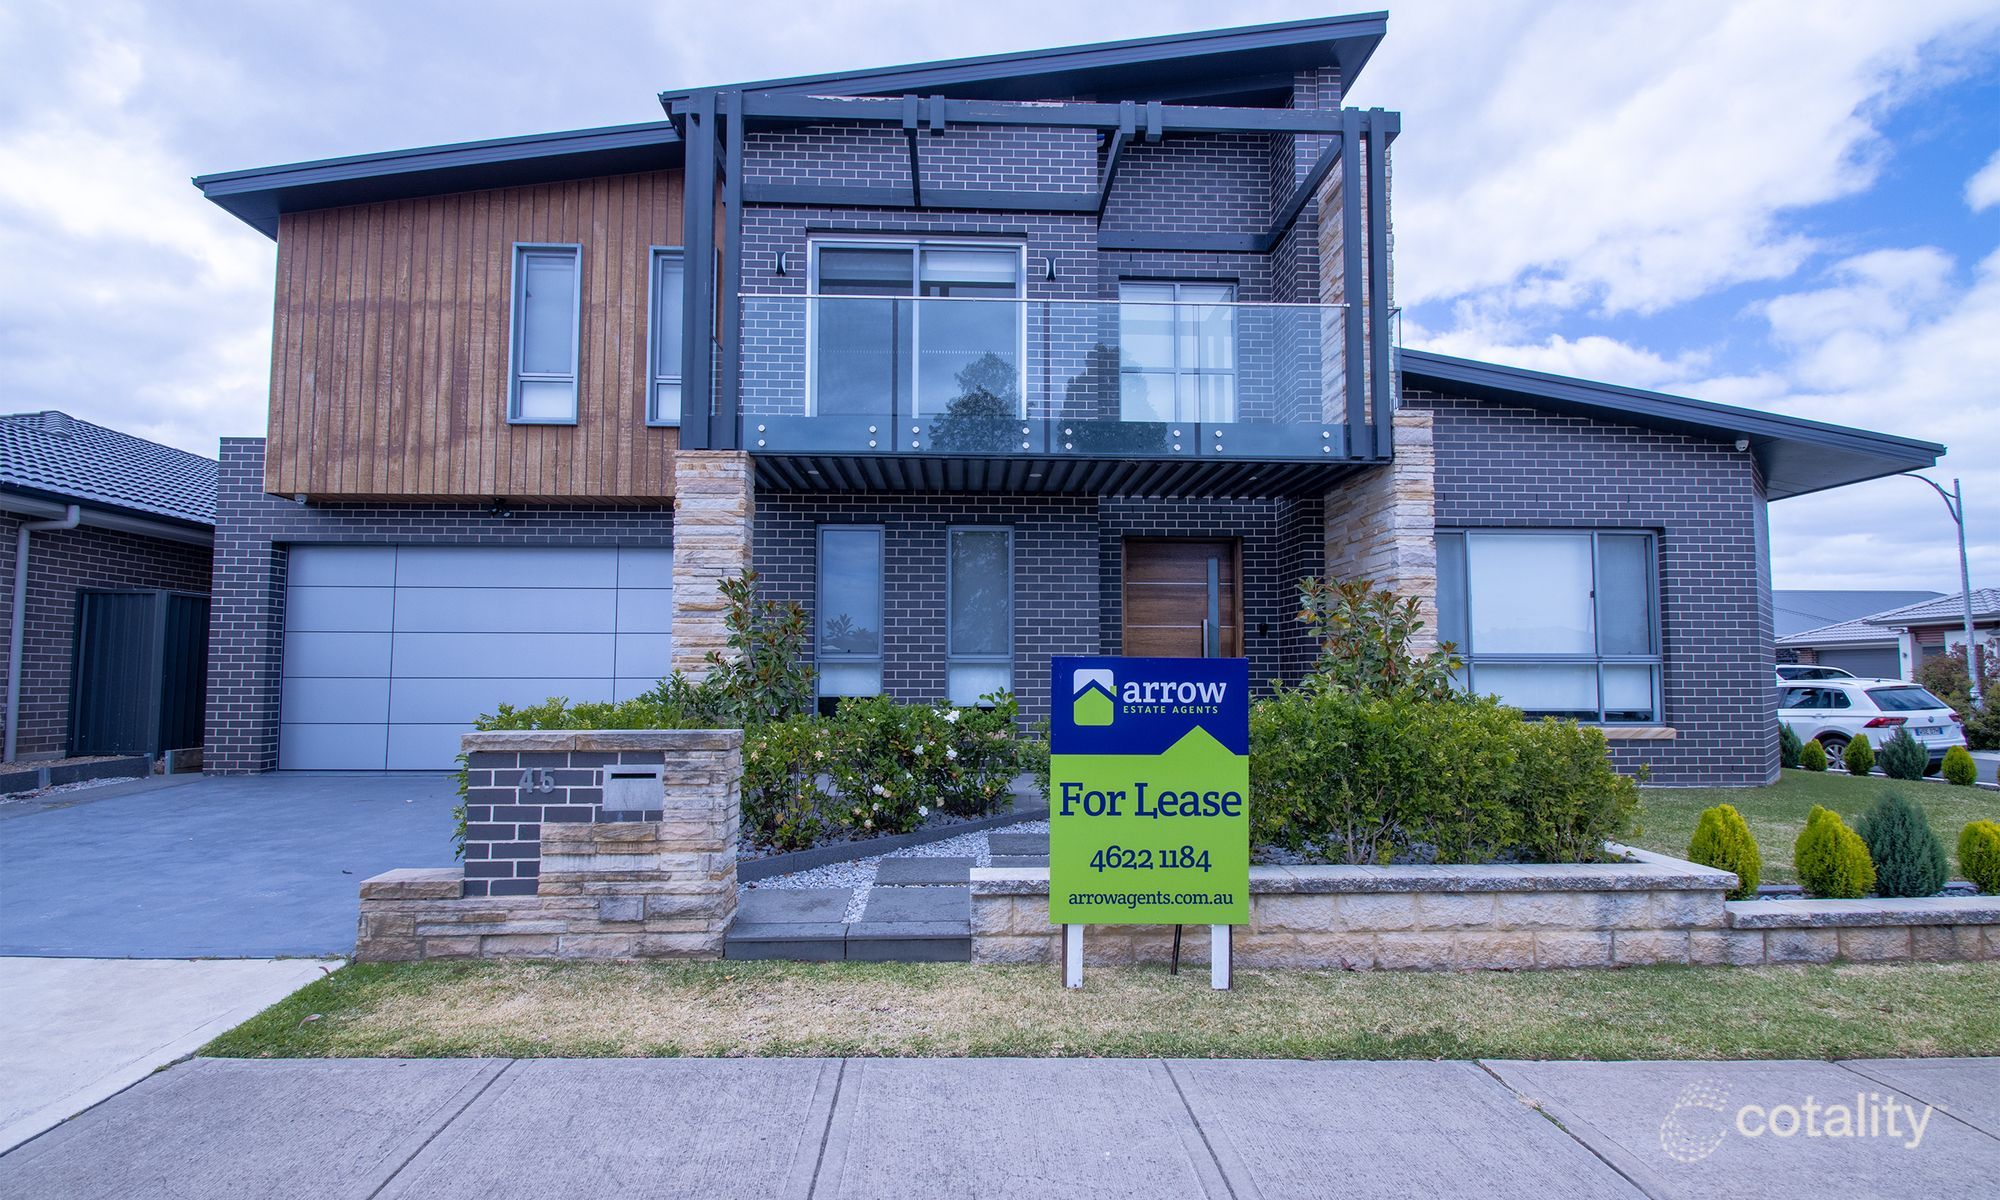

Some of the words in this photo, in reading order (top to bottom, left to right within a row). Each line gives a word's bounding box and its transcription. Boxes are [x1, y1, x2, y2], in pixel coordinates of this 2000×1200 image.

[1122, 682, 1227, 704] arrow
[1123, 705, 1166, 714] ESTATE
[1172, 705, 1218, 714] AGENTS
[518, 767, 555, 794] 45
[1059, 782, 1126, 817] For
[1134, 782, 1242, 819] Lease
[1089, 845, 1153, 873] 4622
[1159, 845, 1212, 873] 1184
[1068, 891, 1233, 909] arrowagents.com.au
